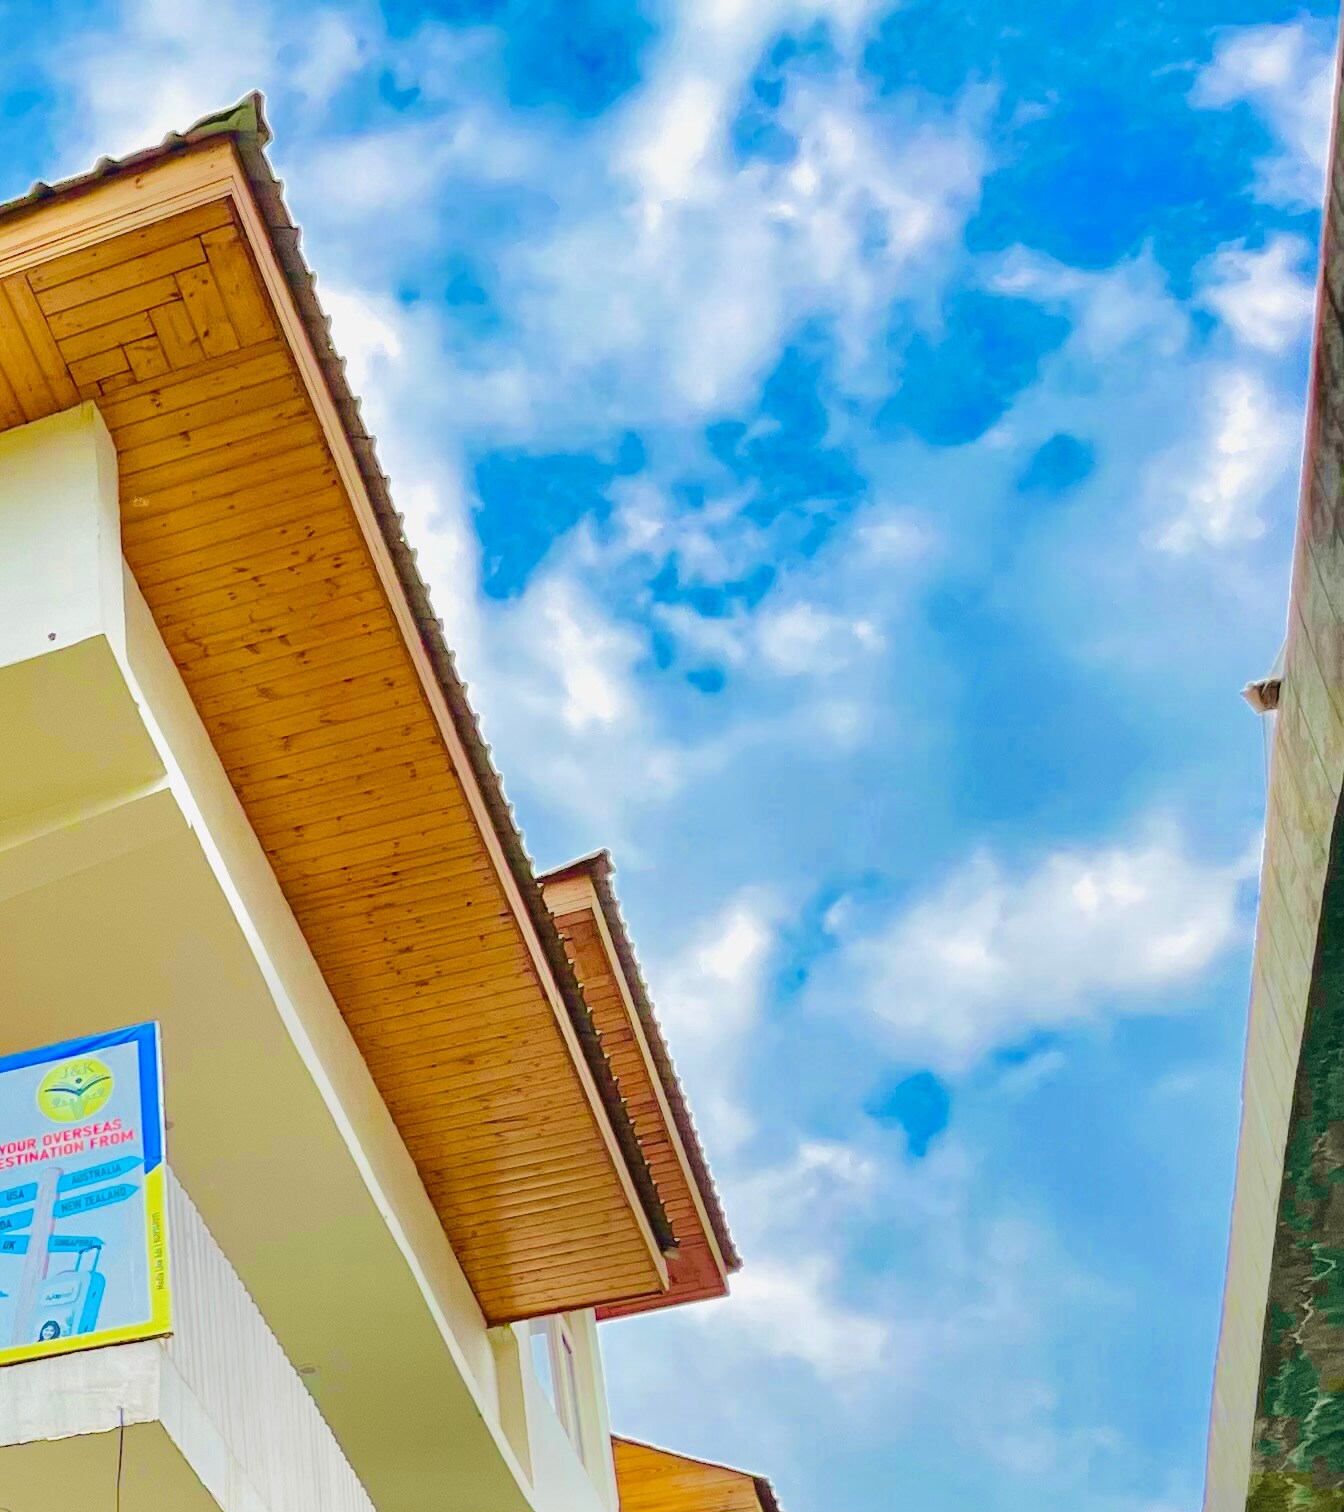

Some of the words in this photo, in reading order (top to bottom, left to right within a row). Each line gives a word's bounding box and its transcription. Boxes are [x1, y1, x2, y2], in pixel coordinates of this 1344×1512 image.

[60, 1062, 95, 1080] J&K
[42, 1118, 123, 1147] OVERSEAS
[90, 1129, 134, 1150] FROM
[71, 1163, 122, 1185] AUSTRALIA
[6, 1190, 25, 1201] USA
[61, 1199, 82, 1213] NEW
[84, 1187, 127, 1207] ZEALAND
